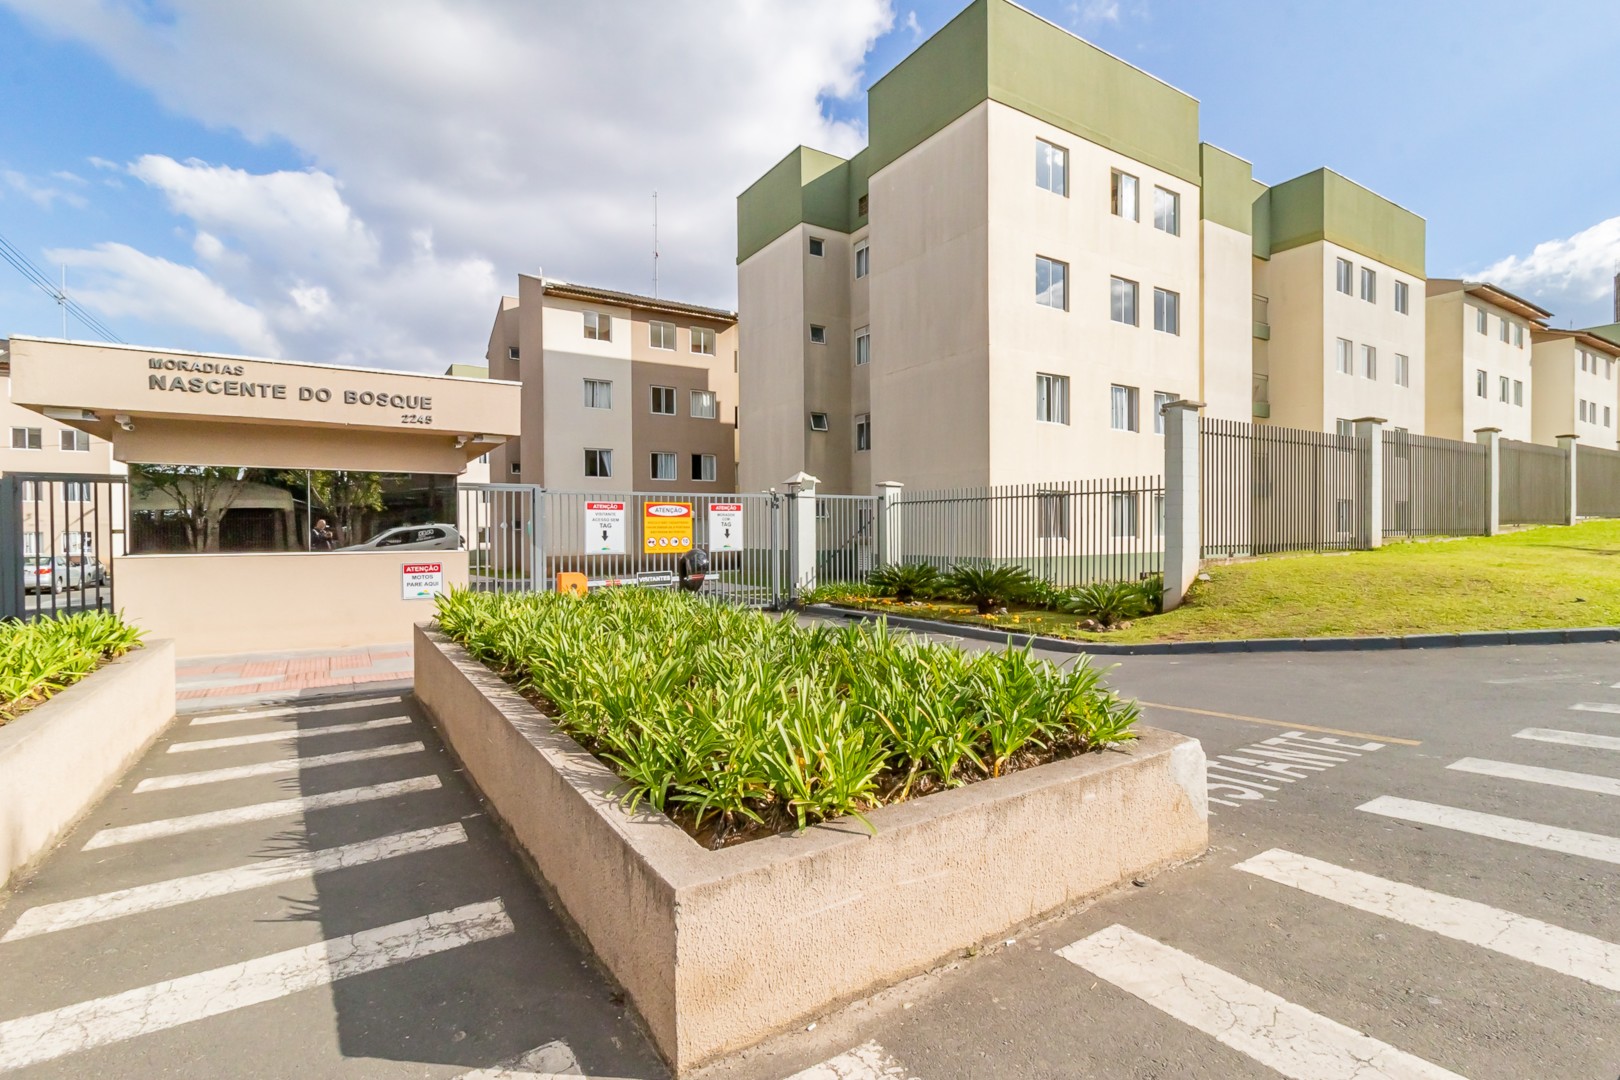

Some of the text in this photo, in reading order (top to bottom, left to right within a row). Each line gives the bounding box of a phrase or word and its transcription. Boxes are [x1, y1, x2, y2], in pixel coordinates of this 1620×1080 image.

[149, 358, 244, 376] MORADIAS
[149, 374, 432, 410] NASCENTE DO BOSQUE
[401, 414, 433, 424] 2245
[406, 564, 439, 572] ATENÇÃO
